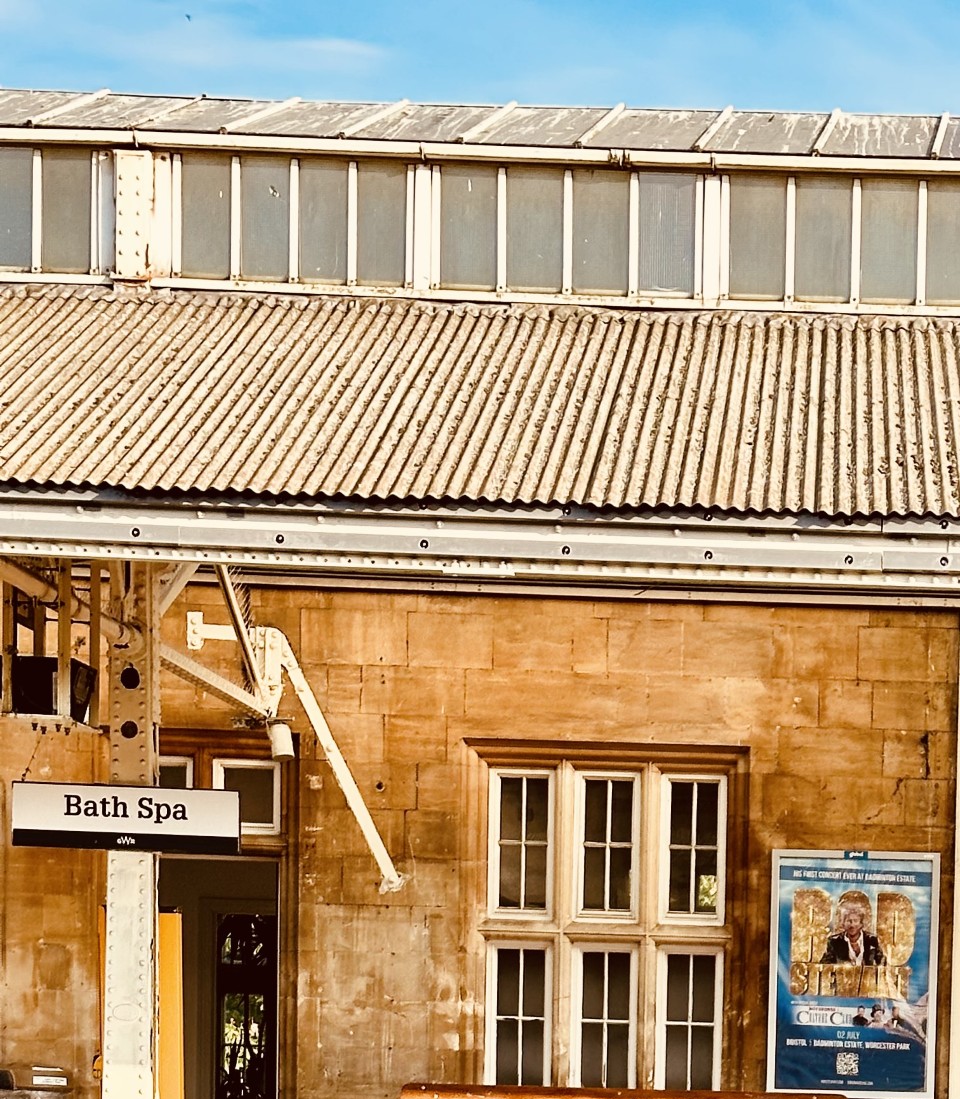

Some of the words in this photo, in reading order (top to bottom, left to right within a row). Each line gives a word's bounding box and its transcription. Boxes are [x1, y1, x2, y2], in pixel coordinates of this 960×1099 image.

[63, 794, 130, 818] Bath
[137, 797, 189, 824] Spa
[803, 870, 818, 879] FIRST
[818, 870, 842, 880] CONCERT
[842, 871, 857, 881] EVER
[857, 872, 865, 881] AT
[896, 874, 917, 884] ESTATE
[790, 887, 916, 968] ROD
[789, 962, 913, 1002] STEWART
[786, 1038, 807, 1047] BRISTOL
[813, 1039, 844, 1048] BADMINTON
[865, 1041, 896, 1051] WORCESTER
[896, 1043, 911, 1052] PARK
[836, 1030, 845, 1039] 02
[845, 1031, 861, 1040] JULY
